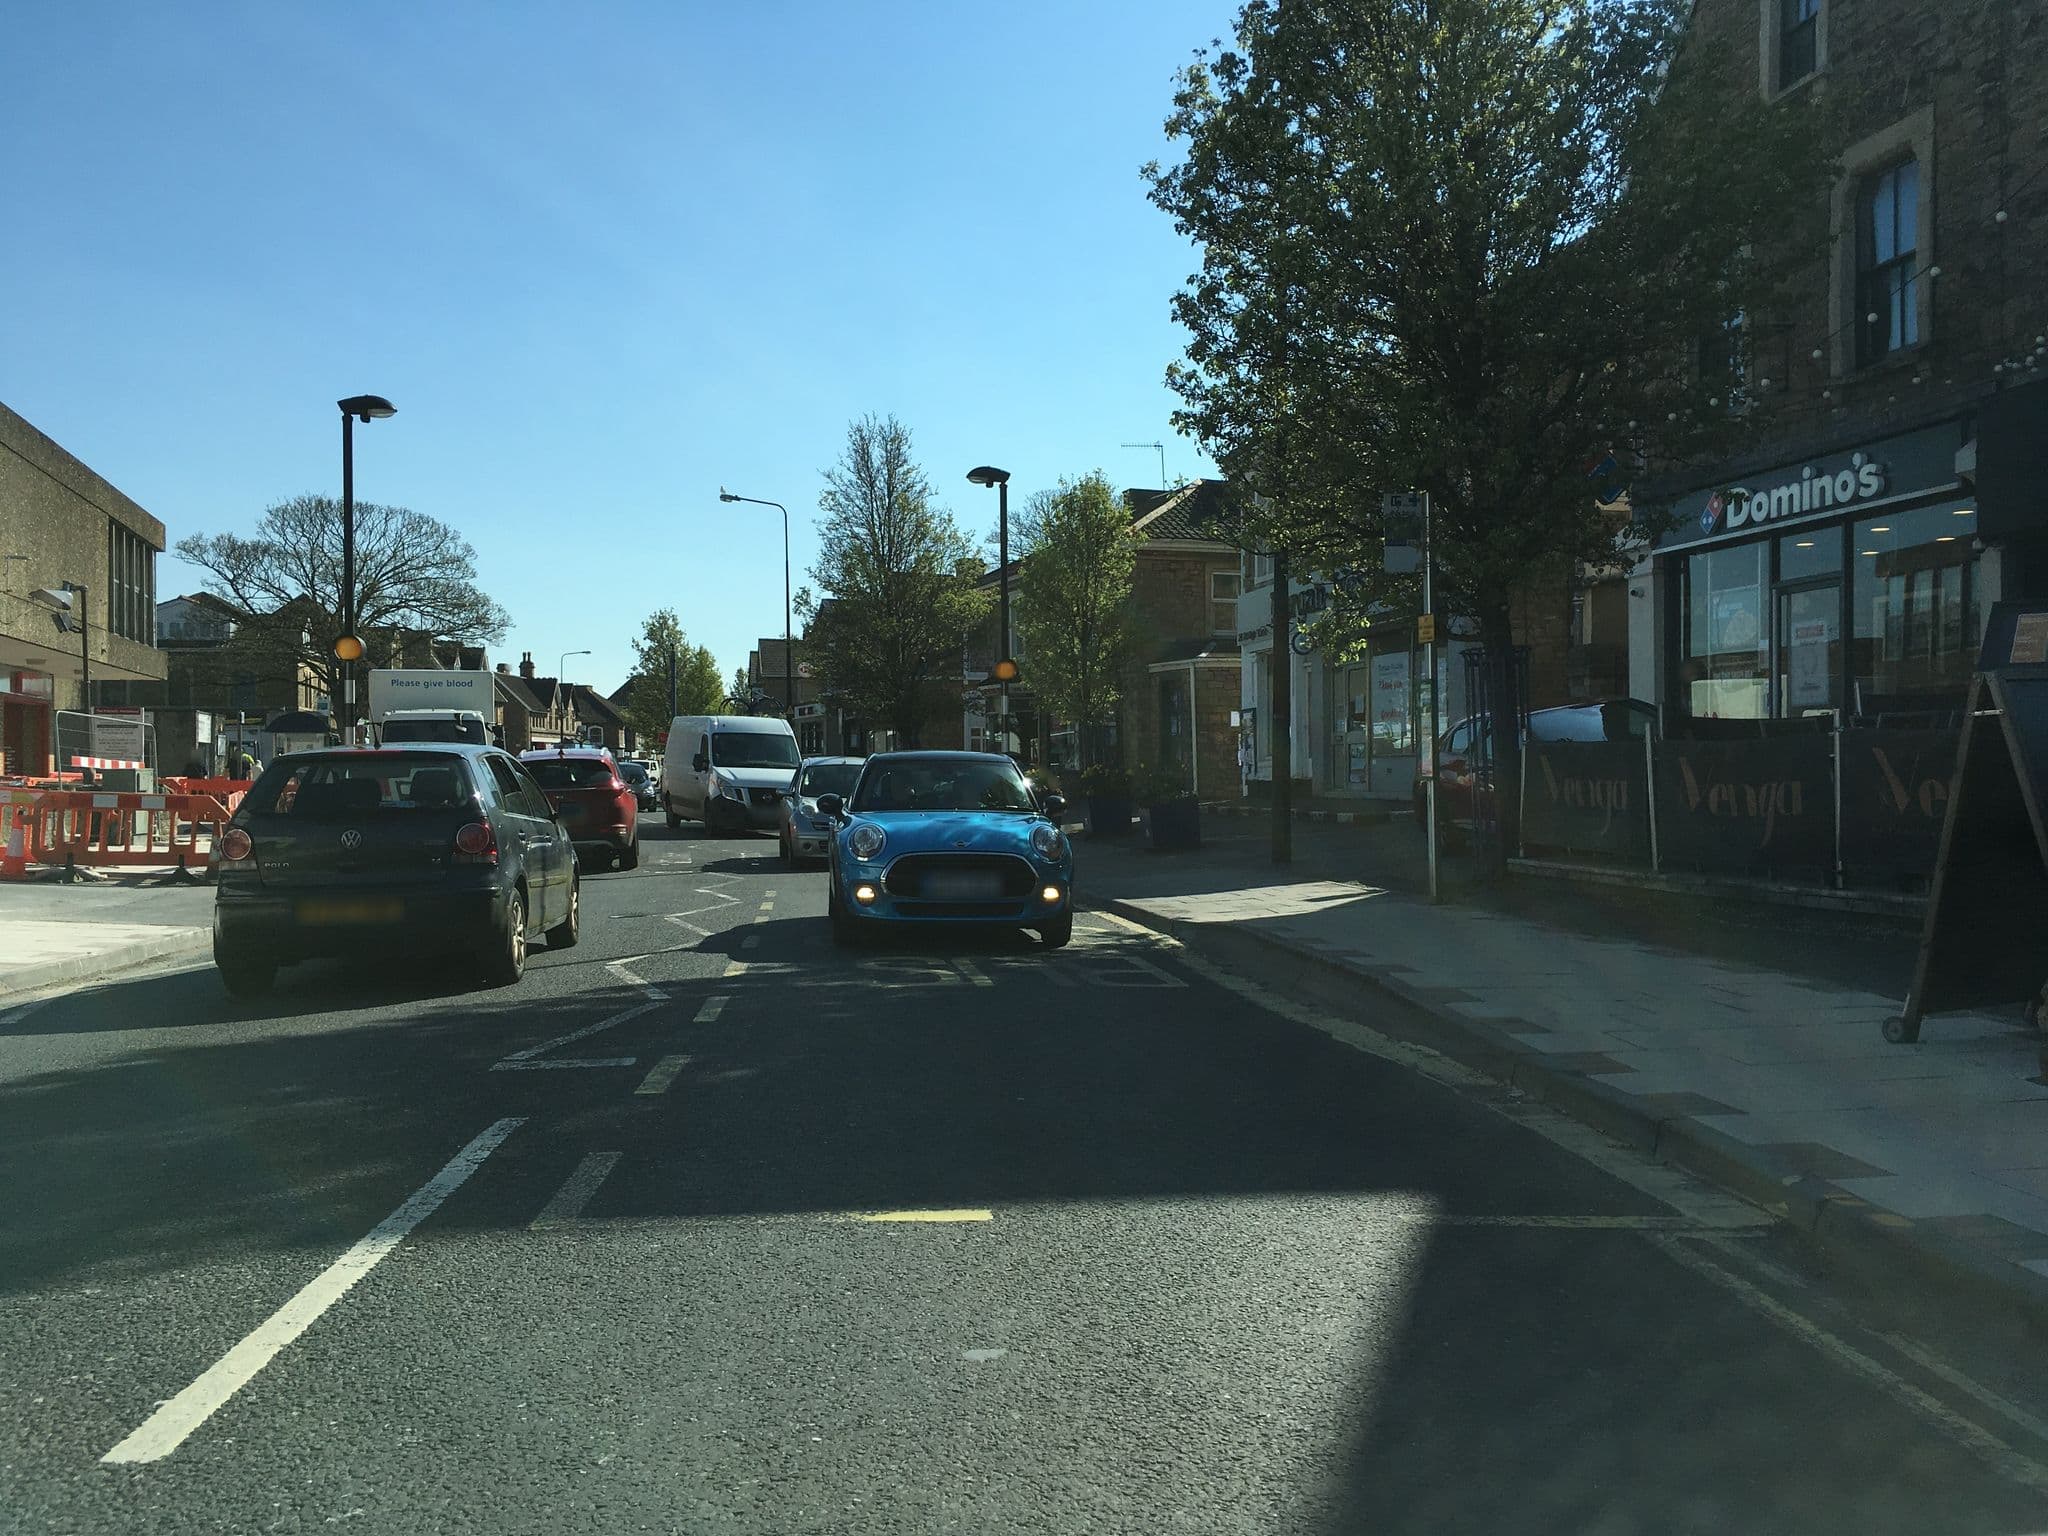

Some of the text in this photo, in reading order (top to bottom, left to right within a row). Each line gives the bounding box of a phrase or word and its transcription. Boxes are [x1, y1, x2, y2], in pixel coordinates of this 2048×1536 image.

[1726, 452, 1885, 529] Domino's
[391, 678, 473, 689] Please give blood
[1678, 756, 1803, 849] Venga
[264, 861, 290, 870] POLO
